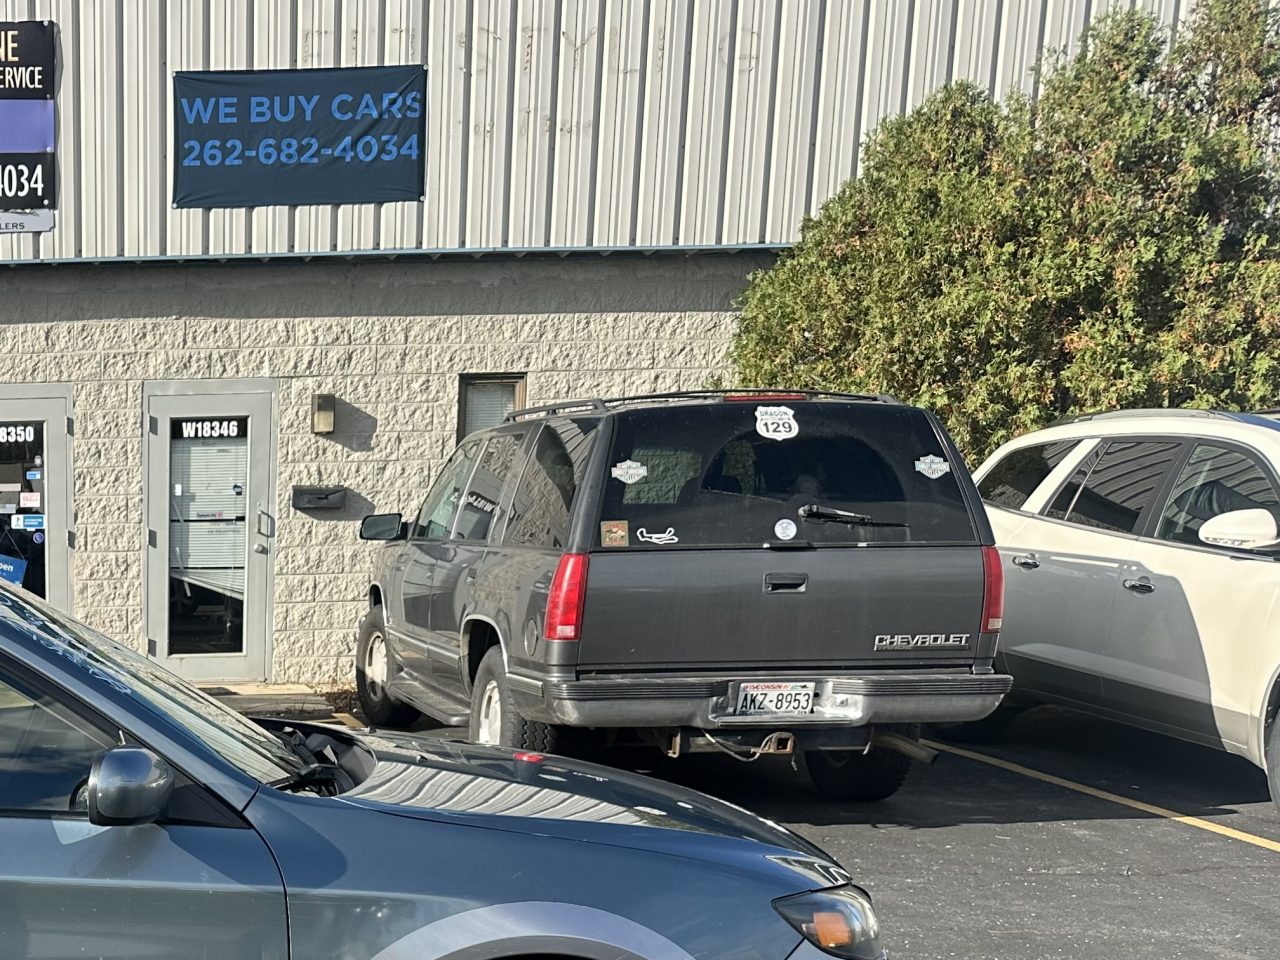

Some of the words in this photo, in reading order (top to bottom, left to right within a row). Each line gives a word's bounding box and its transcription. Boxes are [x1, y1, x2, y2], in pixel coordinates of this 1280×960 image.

[181, 97, 238, 124] WE
[250, 94, 320, 123] BUY
[331, 91, 421, 121] CARS
[182, 134, 419, 166] 262-682-4034
[182, 421, 238, 438] W18346
[763, 421, 793, 433] 129
[874, 633, 970, 646] CHEVROLET
[740, 692, 811, 710] AKZ-8953
